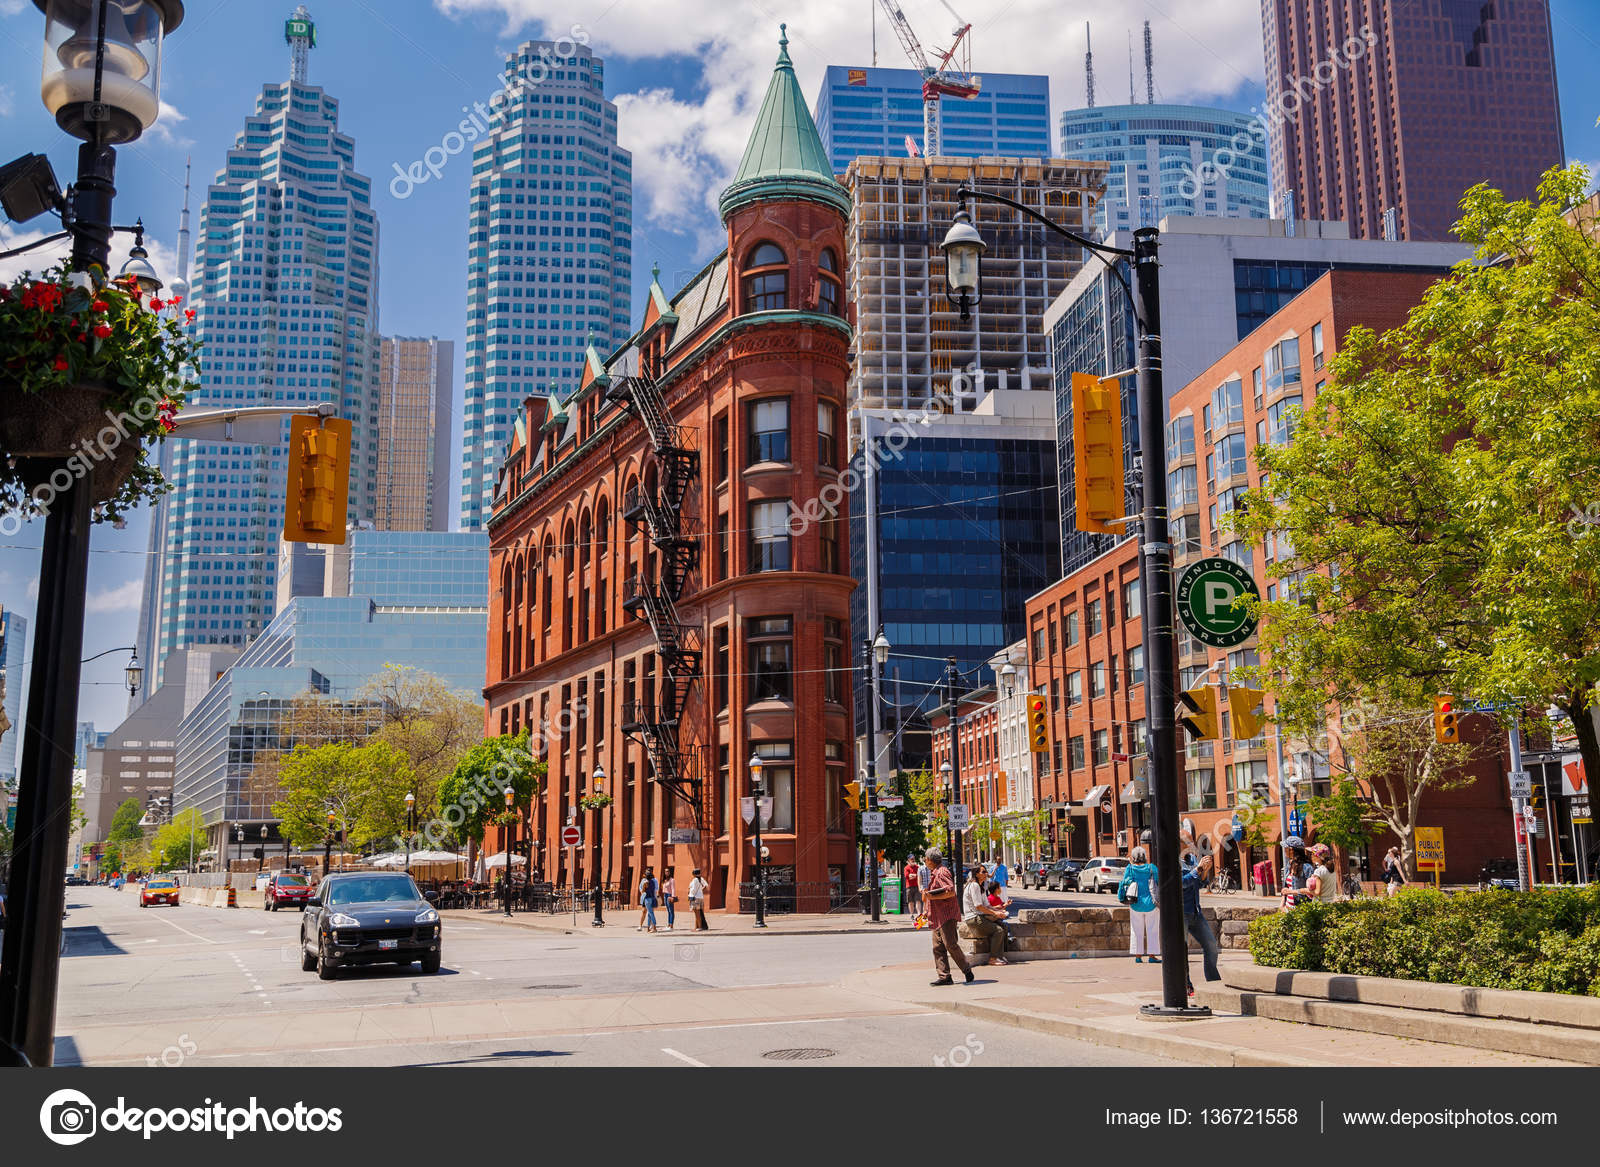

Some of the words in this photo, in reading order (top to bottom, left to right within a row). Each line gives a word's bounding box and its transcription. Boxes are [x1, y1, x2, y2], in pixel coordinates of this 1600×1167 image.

[290, 22, 306, 33] TD
[1181, 562, 1252, 598] MUNICIPA
[1205, 581, 1236, 614] P
[1512, 789, 1531, 797] BEGINS
[1418, 840, 1441, 849] PUBLIC
[1417, 850, 1444, 860] PARKING
